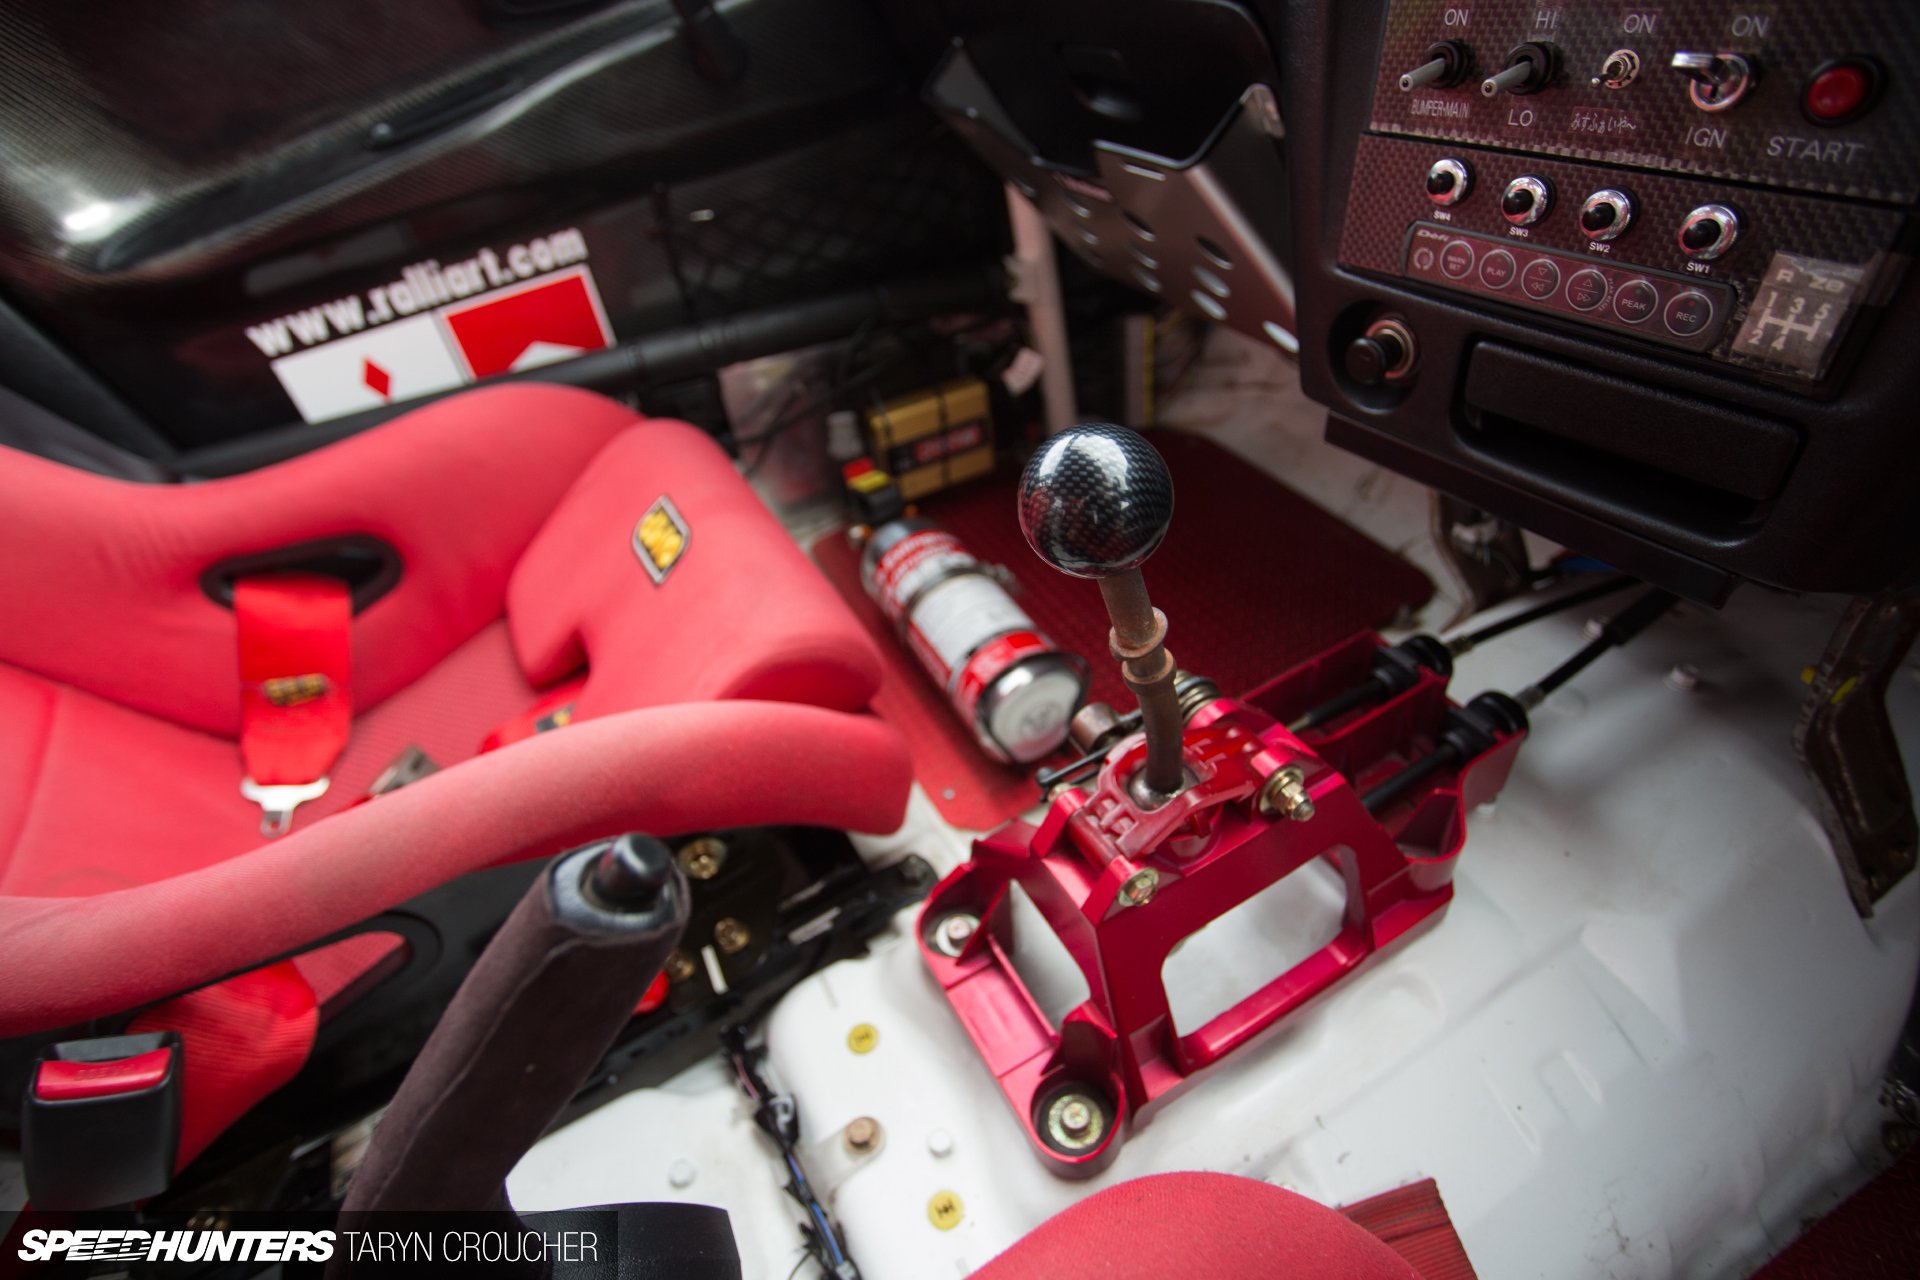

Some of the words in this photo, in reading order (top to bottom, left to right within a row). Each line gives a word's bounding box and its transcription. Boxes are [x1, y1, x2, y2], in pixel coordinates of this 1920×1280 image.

[1444, 8, 1469, 26] ON
[1535, 11, 1557, 29] HI
[1623, 14, 1657, 34] ON
[1731, 16, 1769, 37] ON
[1507, 109, 1534, 127] LO
[1684, 126, 1727, 149] IGN
[1767, 136, 1865, 164] START
[1508, 227, 1529, 238] SW3
[1588, 242, 1611, 253] SW2
[1486, 266, 1507, 278] PLAY
[1686, 262, 1711, 274] SW1
[1776, 269, 1795, 283] R
[245, 227, 589, 358] www.ralliart.com
[1621, 298, 1647, 311] PEAK
[1767, 291, 1778, 308] 1
[1789, 297, 1805, 314] 3
[1814, 303, 1832, 320] 5
[1675, 311, 1697, 323] REC
[1748, 329, 1763, 345] 2
[1771, 336, 1787, 351] 4
